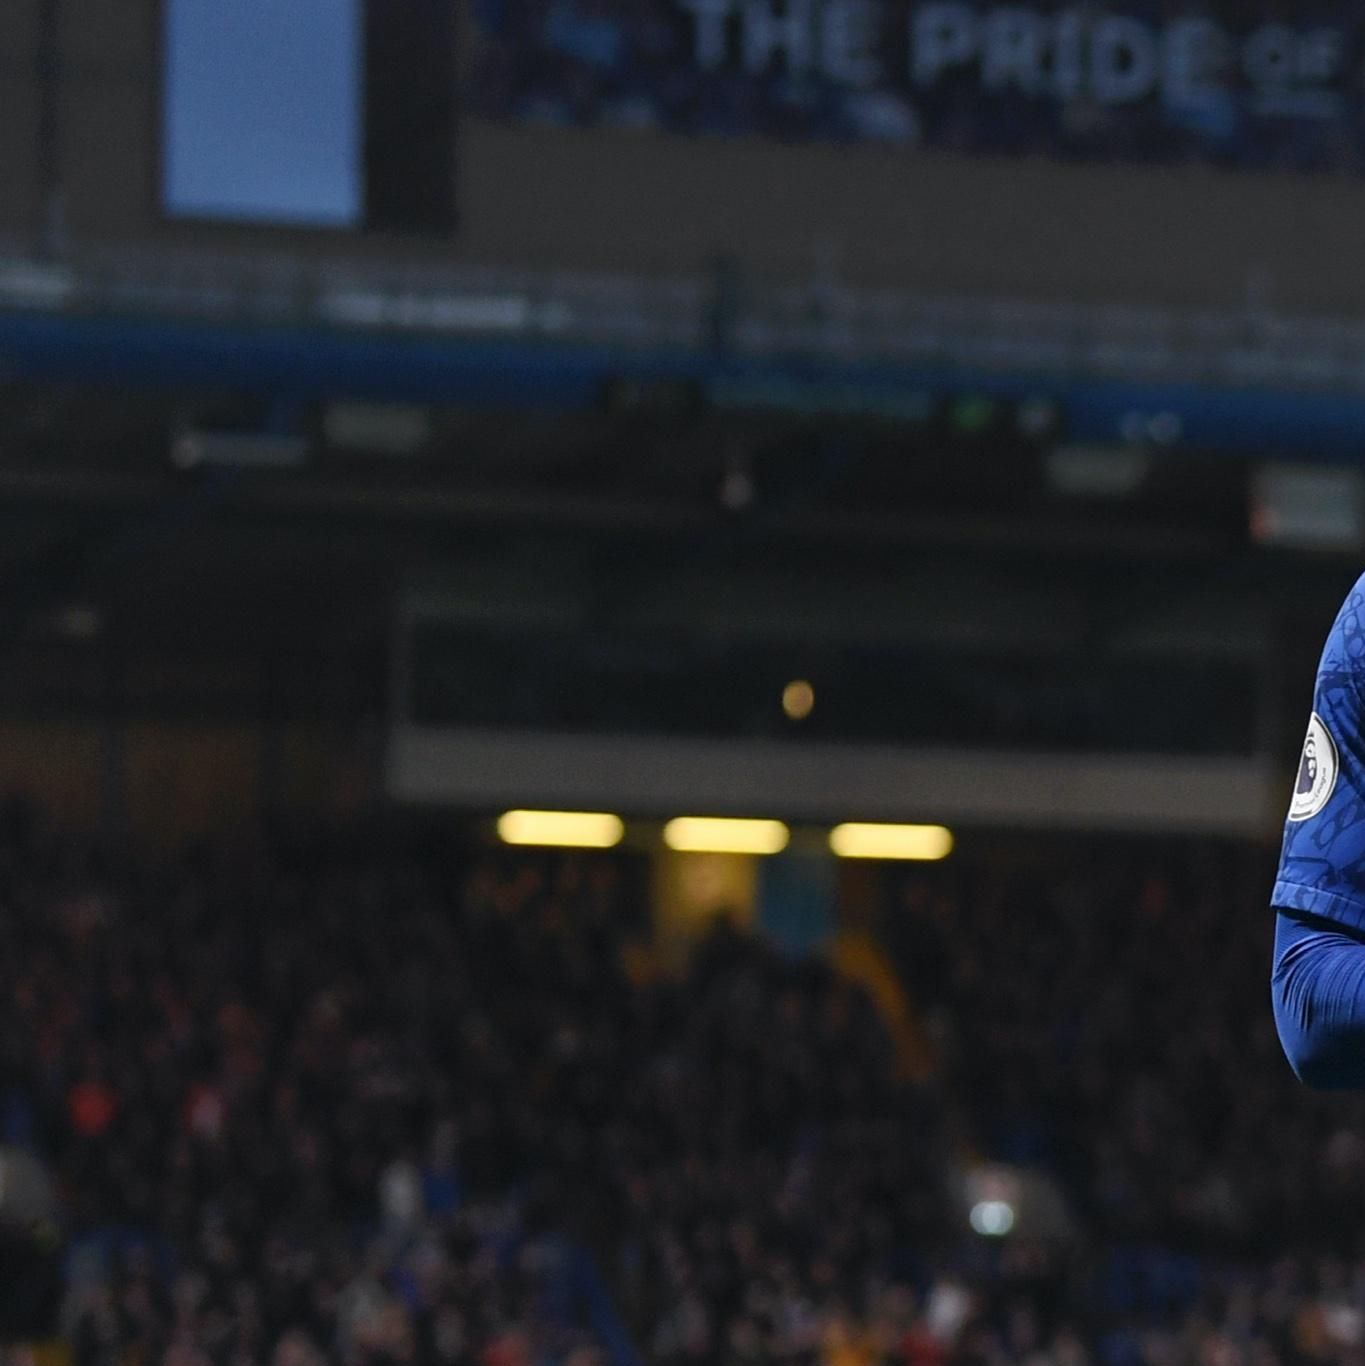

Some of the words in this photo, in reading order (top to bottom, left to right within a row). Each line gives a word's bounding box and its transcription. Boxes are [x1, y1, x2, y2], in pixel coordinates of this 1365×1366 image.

[678, 0, 878, 86] THE
[911, 5, 1232, 110] PRIDE
[1243, 26, 1342, 90] OF
